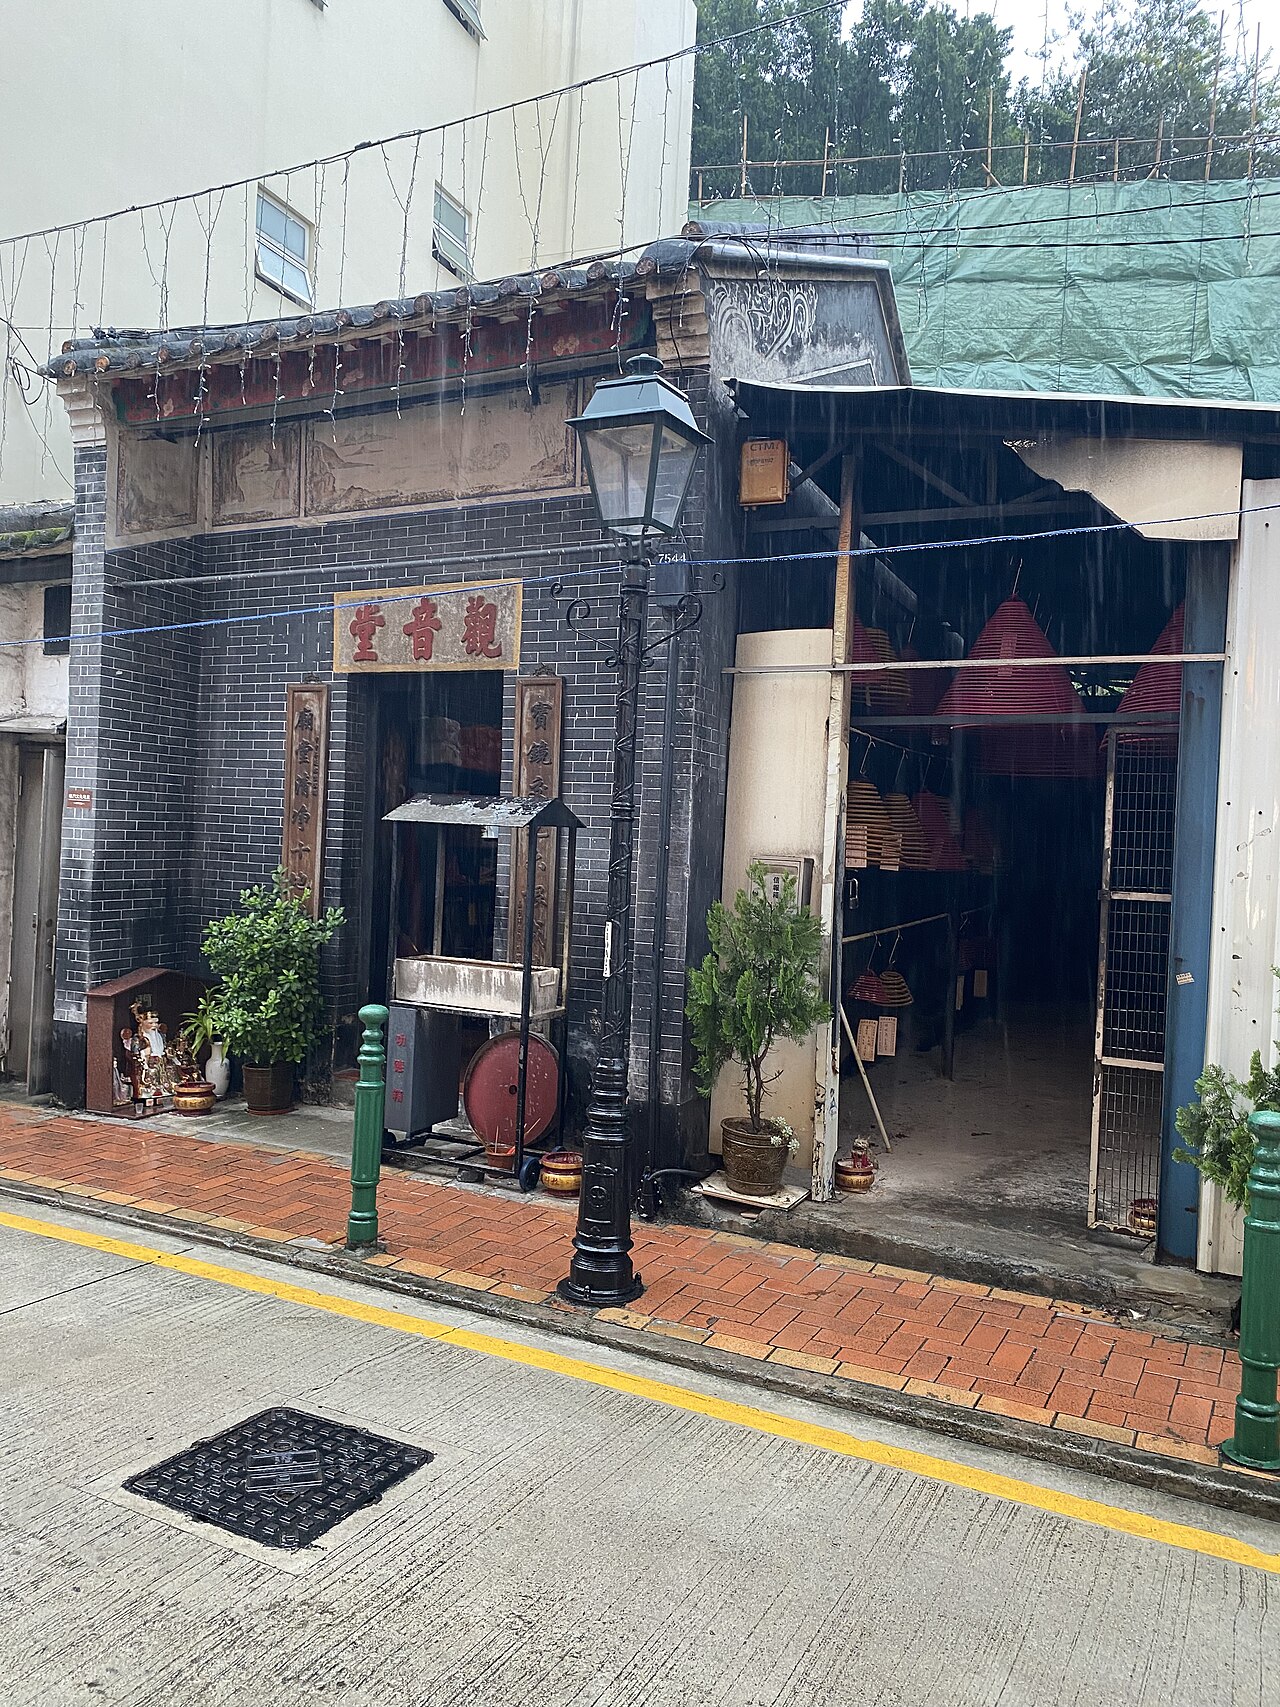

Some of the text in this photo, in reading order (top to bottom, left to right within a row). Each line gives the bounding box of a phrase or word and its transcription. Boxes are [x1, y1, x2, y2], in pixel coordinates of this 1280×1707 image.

[658, 552, 686, 563] 7544
[350, 595, 503, 662] 觀音堂
